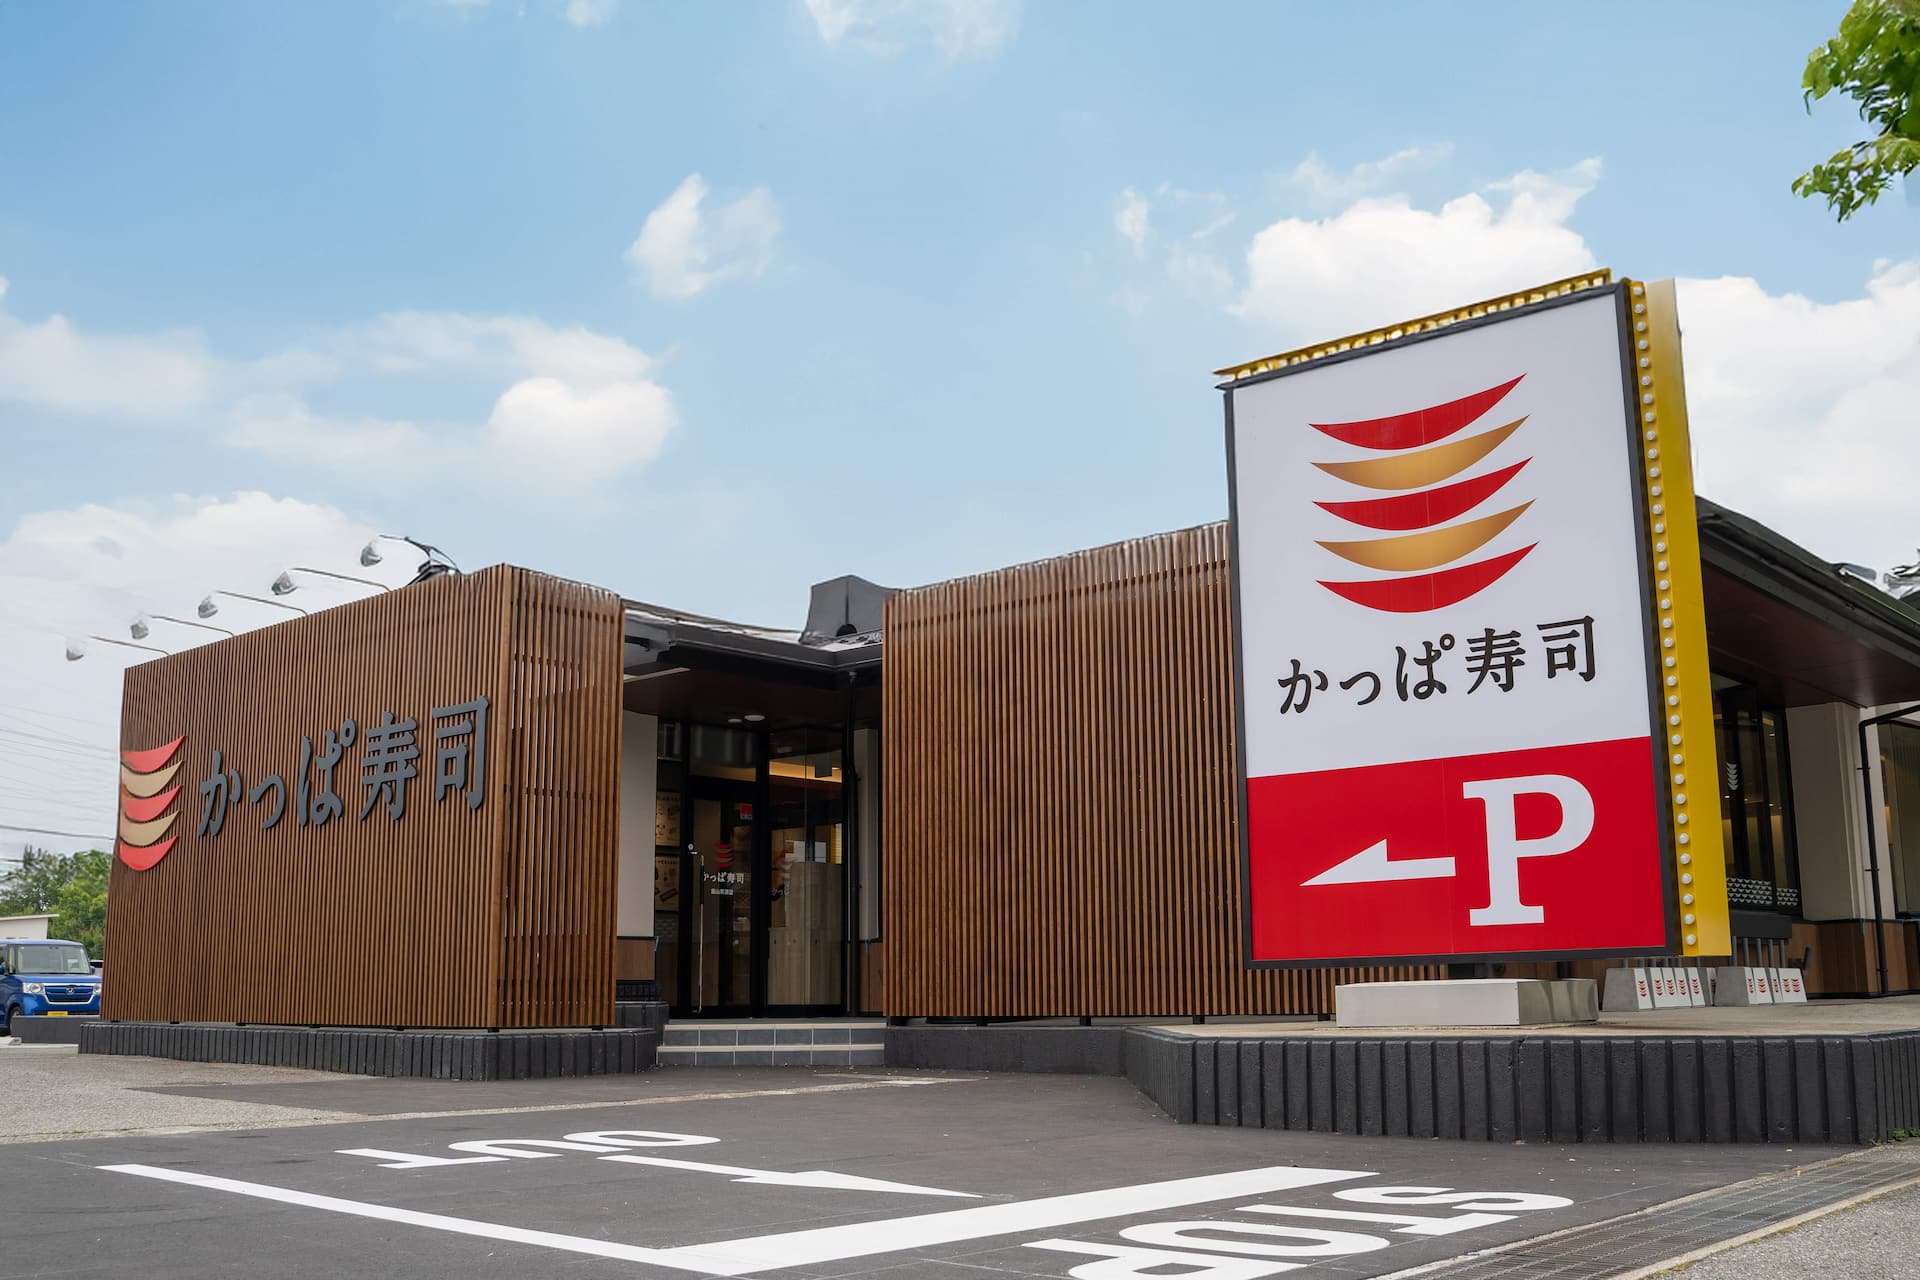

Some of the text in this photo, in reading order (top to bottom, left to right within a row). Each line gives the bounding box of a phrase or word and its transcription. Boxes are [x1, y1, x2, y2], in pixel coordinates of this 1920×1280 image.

[1278, 615, 1596, 714] かっぱ寿司
[198, 695, 490, 838] かっぱ寿司
[1462, 774, 1595, 926] P
[334, 1130, 721, 1169] OUT
[1020, 1186, 1574, 1280] STOP
